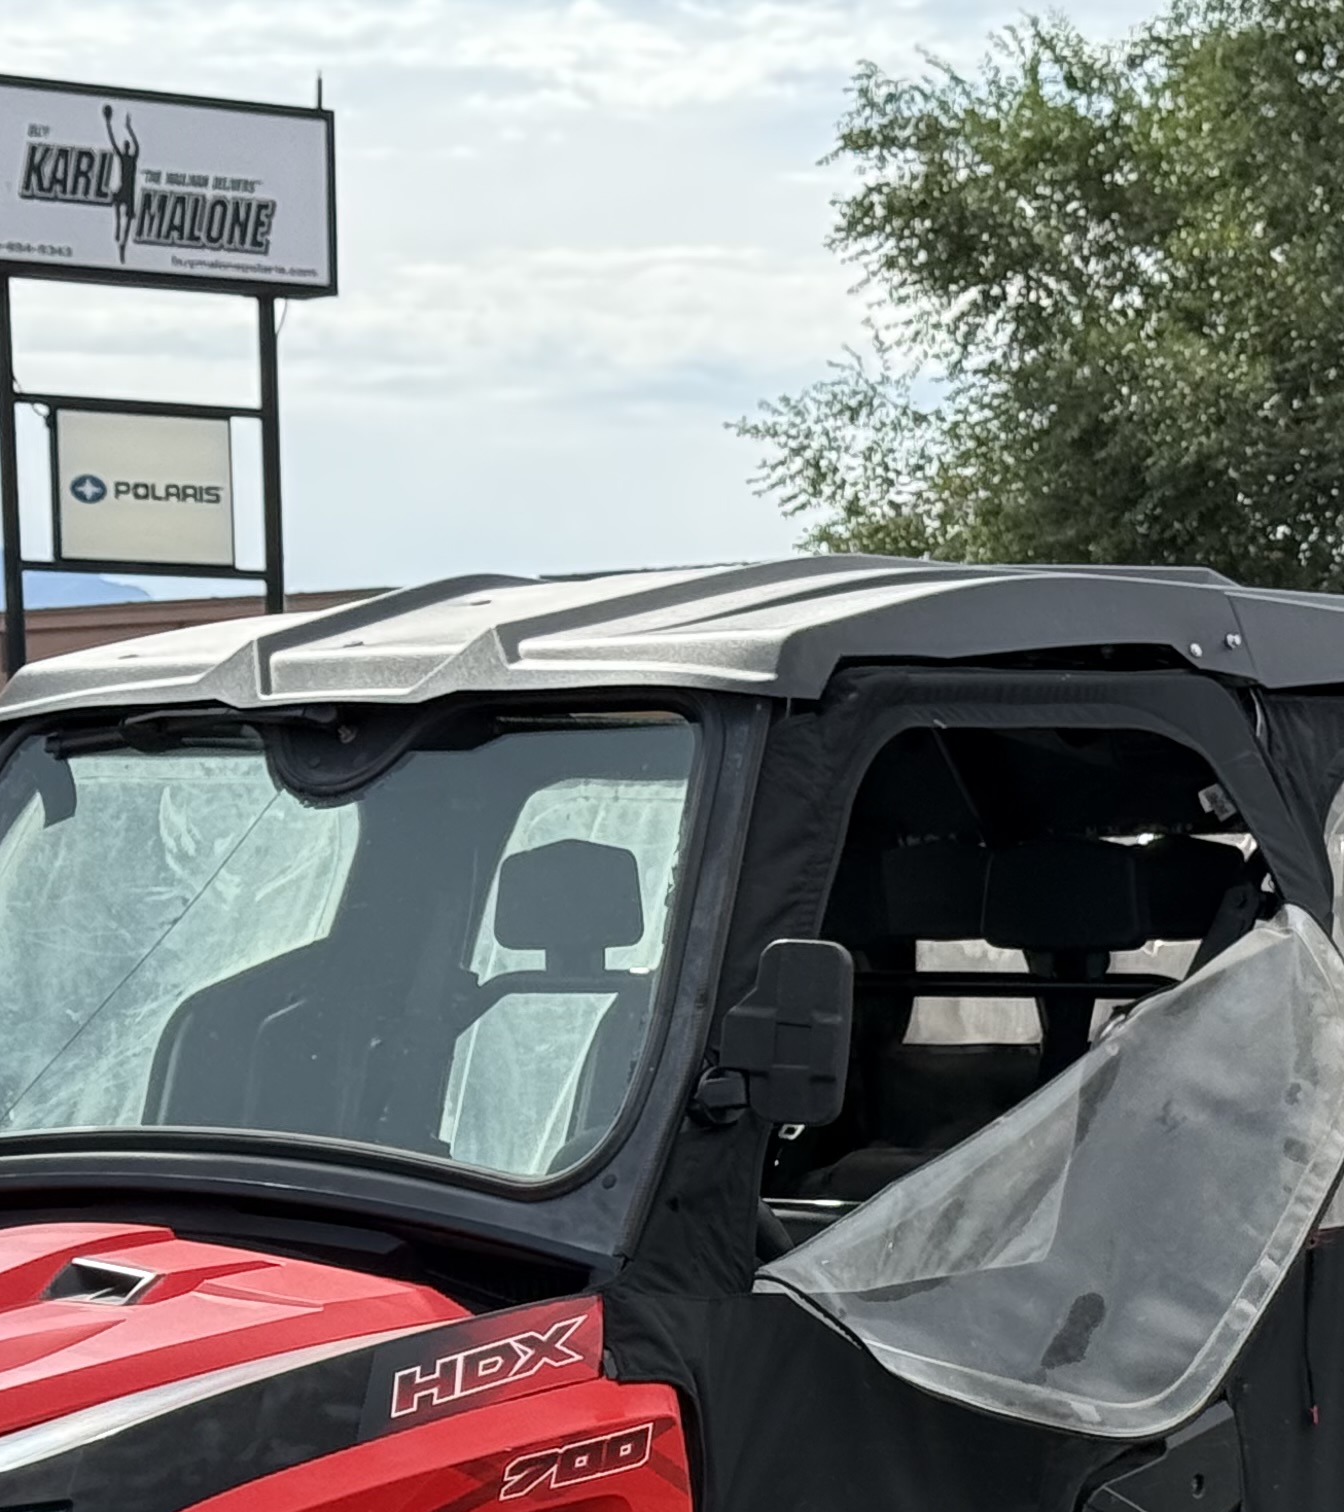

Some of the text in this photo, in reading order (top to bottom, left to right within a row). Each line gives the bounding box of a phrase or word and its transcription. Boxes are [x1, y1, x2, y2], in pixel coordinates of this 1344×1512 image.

[19, 143, 113, 206] KARL
[133, 188, 277, 255] MALONE
[113, 481, 224, 505] POLARIS
[390, 1313, 589, 1419] HDX
[498, 1421, 654, 1501] 700
